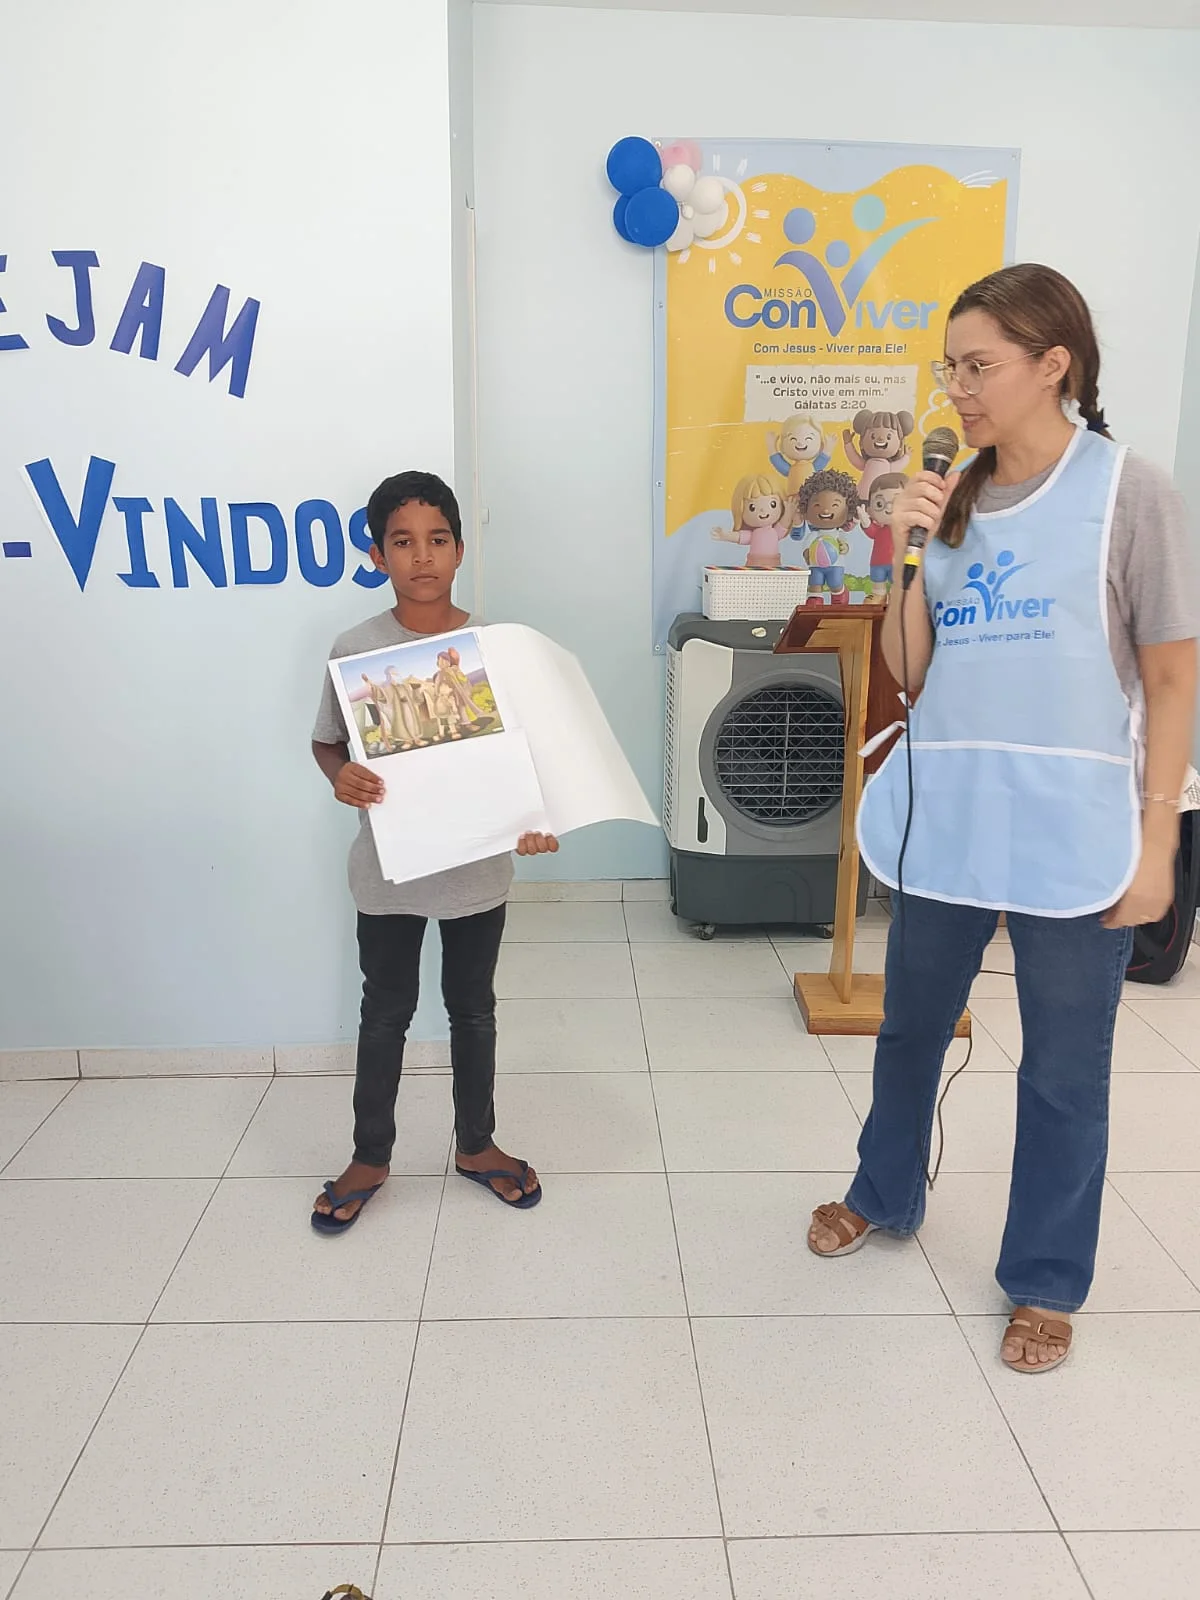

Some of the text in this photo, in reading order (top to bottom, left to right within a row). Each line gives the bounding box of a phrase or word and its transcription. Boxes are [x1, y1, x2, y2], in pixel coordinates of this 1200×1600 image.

[763, 286, 813, 298] MISSÃO
[753, 343, 779, 353] Com
[783, 343, 816, 353] Jesus
[826, 343, 854, 353] Viver
[858, 345, 882, 355] para
[885, 343, 907, 353] Ele!
[780, 374, 807, 385] vivo,
[810, 374, 831, 384] não
[834, 374, 860, 384] mais
[864, 375, 881, 385] eu,
[883, 375, 907, 384] mas
[773, 387, 808, 397] Cristo
[812, 387, 835, 397] vive
[838, 388, 855, 397] em
[794, 399, 867, 410] Gálatas 2:20
[942, 637, 970, 647] Jesus
[978, 633, 1003, 643] Viver
[1006, 632, 1031, 642] para
[1034, 630, 1055, 640] Ele!
